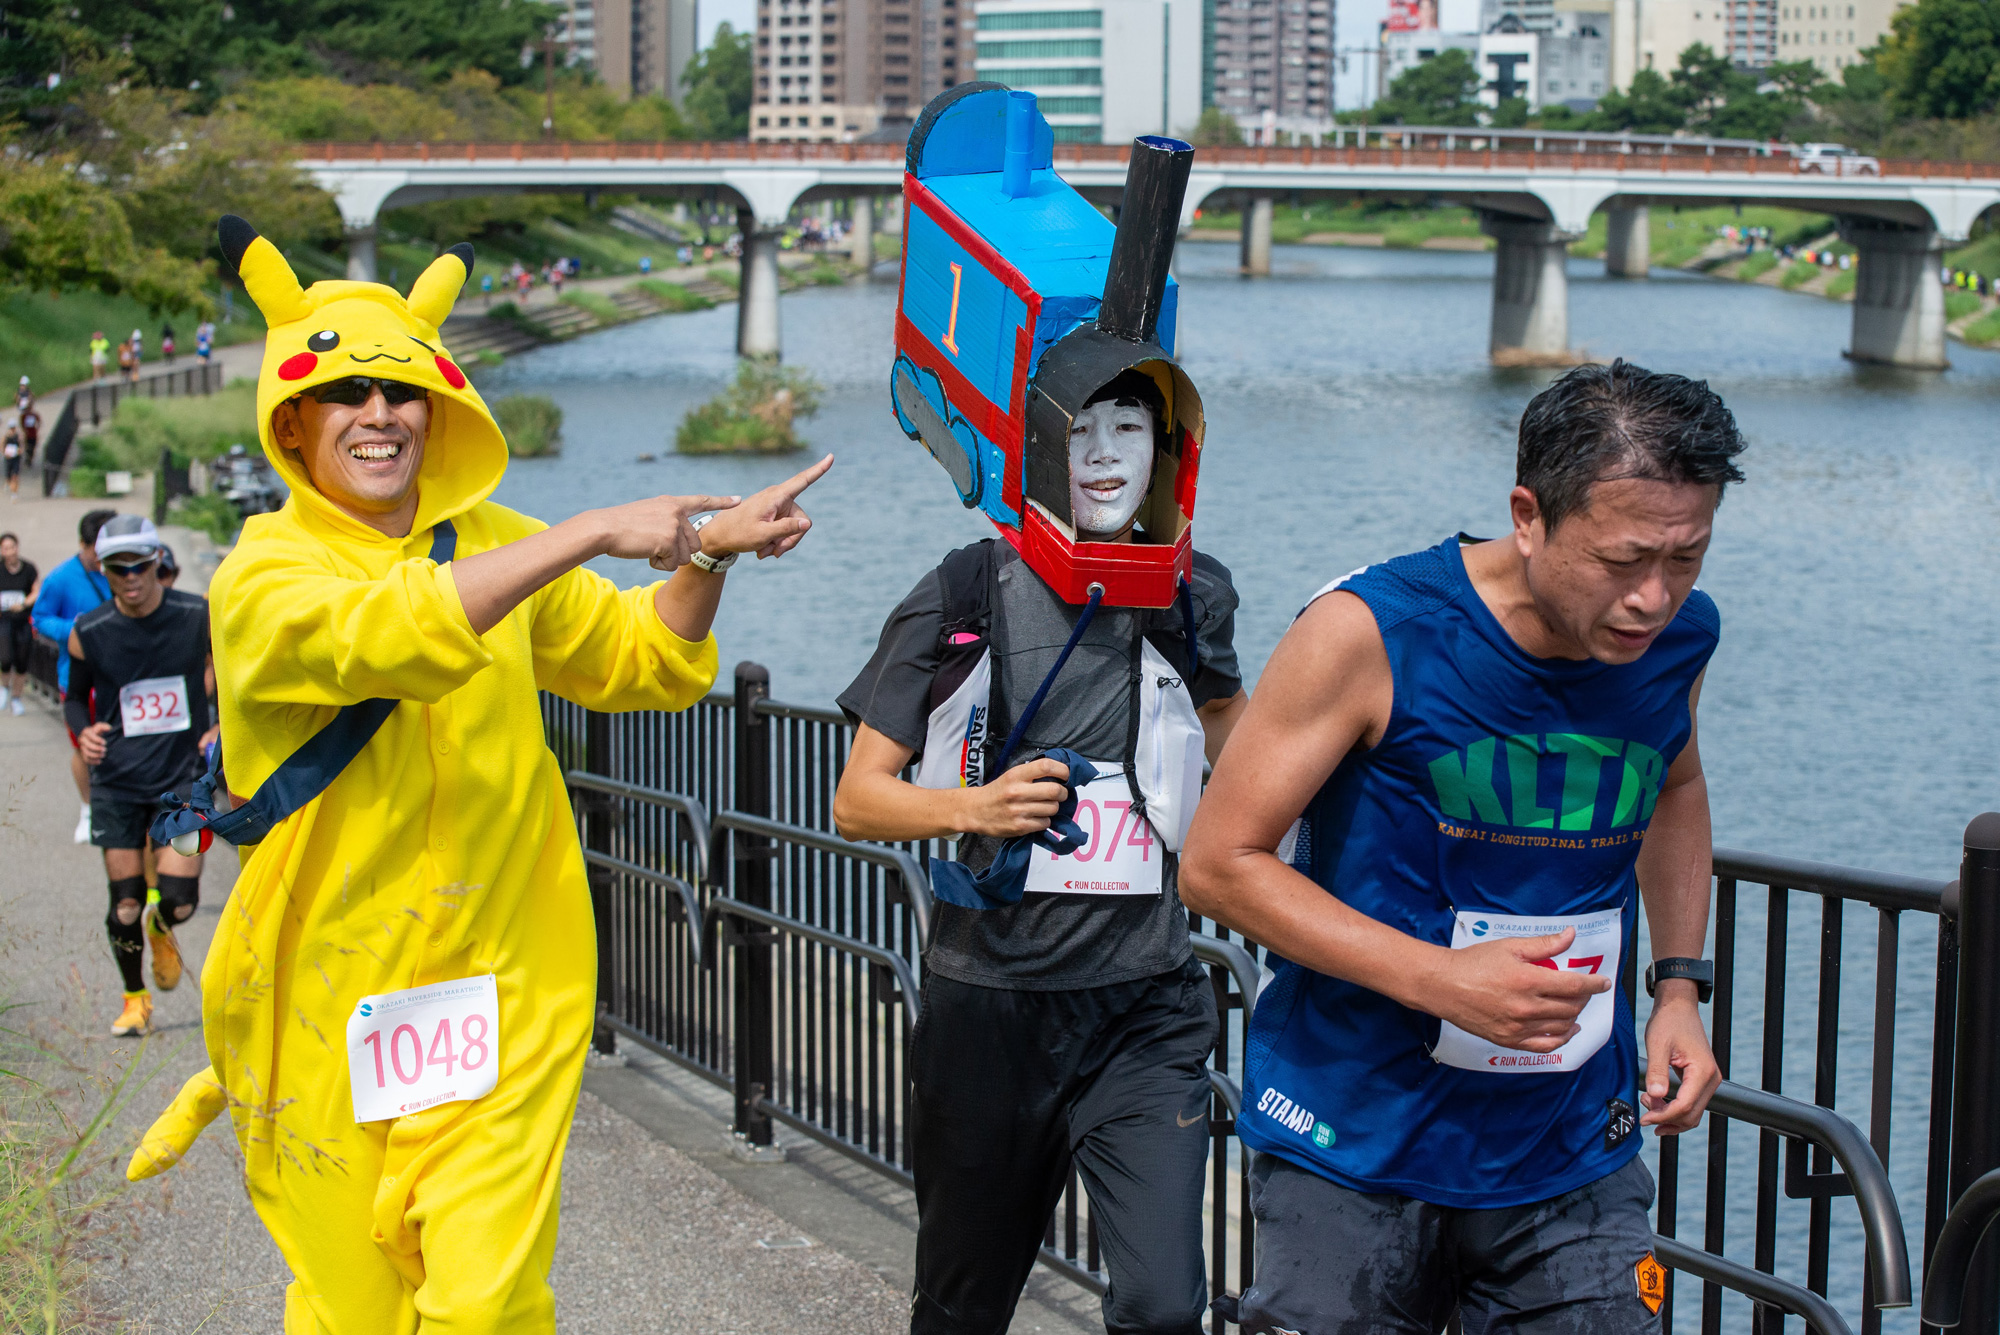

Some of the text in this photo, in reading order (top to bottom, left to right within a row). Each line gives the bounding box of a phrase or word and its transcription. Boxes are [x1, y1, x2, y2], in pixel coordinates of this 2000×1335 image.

[941, 261, 962, 358] 1
[130, 691, 181, 721] 332
[1427, 733, 1664, 830] KLTR
[1438, 822, 1486, 840] KANSAI
[1491, 832, 1585, 849] LONGITUDINAL
[1591, 833, 1628, 848] TRAIL
[1074, 881, 1130, 891] RUN COLLECTION
[1493, 923, 1531, 932] OKAZAKI
[1577, 918, 1610, 931] MARATHON
[376, 985, 484, 1010] OKAZAKI RIVERSIDE MARATHON
[363, 1014, 489, 1089] 1048
[1500, 1054, 1563, 1066] RUN COLLECTION
[409, 1090, 457, 1111] RUN COLLECTION
[1257, 1087, 1315, 1135] STAMP
[1318, 1124, 1330, 1137] RUN
